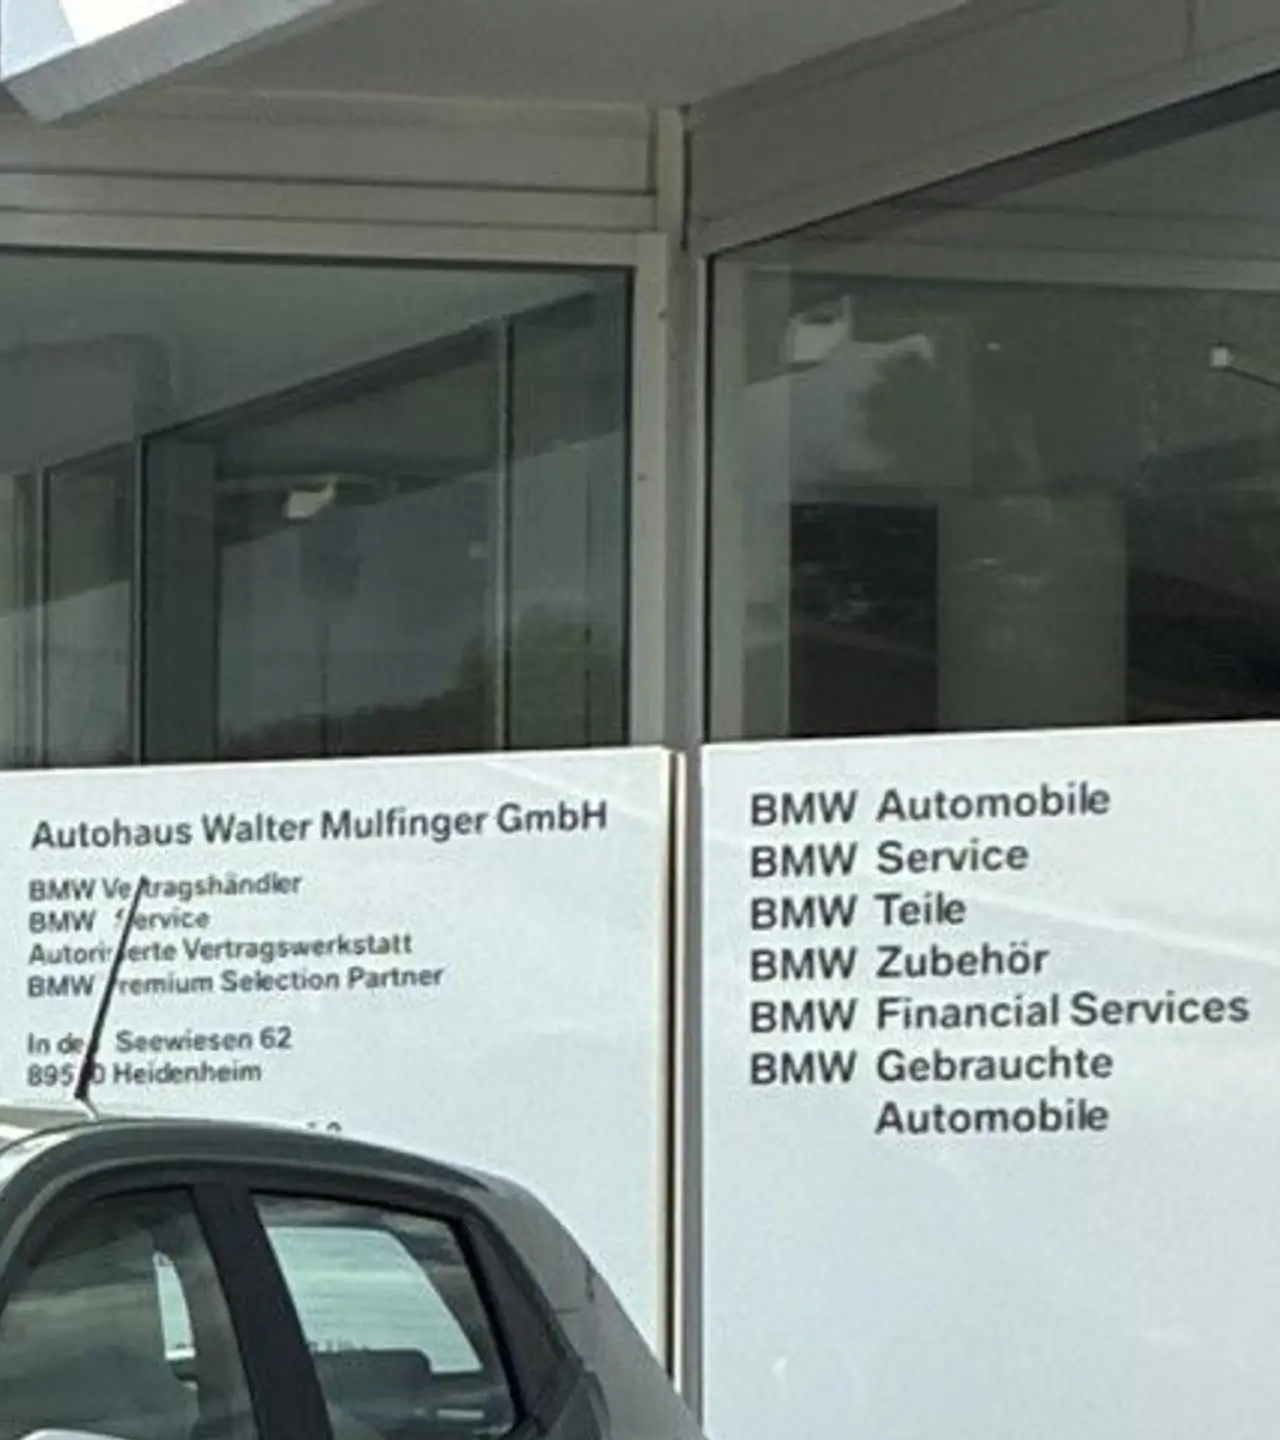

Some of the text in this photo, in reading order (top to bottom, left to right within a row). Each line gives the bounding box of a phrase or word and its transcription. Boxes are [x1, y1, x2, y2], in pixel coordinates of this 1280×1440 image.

[751, 781, 1110, 826] BMW Automobile
[31, 800, 606, 849] Autohaus Walter Mulfinger GmbH
[751, 838, 1029, 878] BMW Service
[29, 872, 303, 902] BMW Vetragshändler
[29, 910, 96, 934] BMW
[751, 892, 966, 930] BMW Teile
[182, 934, 412, 964] Vertragswerkstatt
[751, 941, 1050, 982] BMW Zubehör
[28, 966, 444, 998] BMW remium Selection Partner
[751, 990, 1249, 1033] BMW Financial Services
[27, 1033, 51, 1055] In
[116, 1029, 253, 1053] Seewiesen
[260, 1026, 292, 1049] 62
[113, 1060, 262, 1085] Heidenheim
[751, 1046, 1113, 1085] BMW Gebrauchte
[875, 1098, 1109, 1135] Automobile
